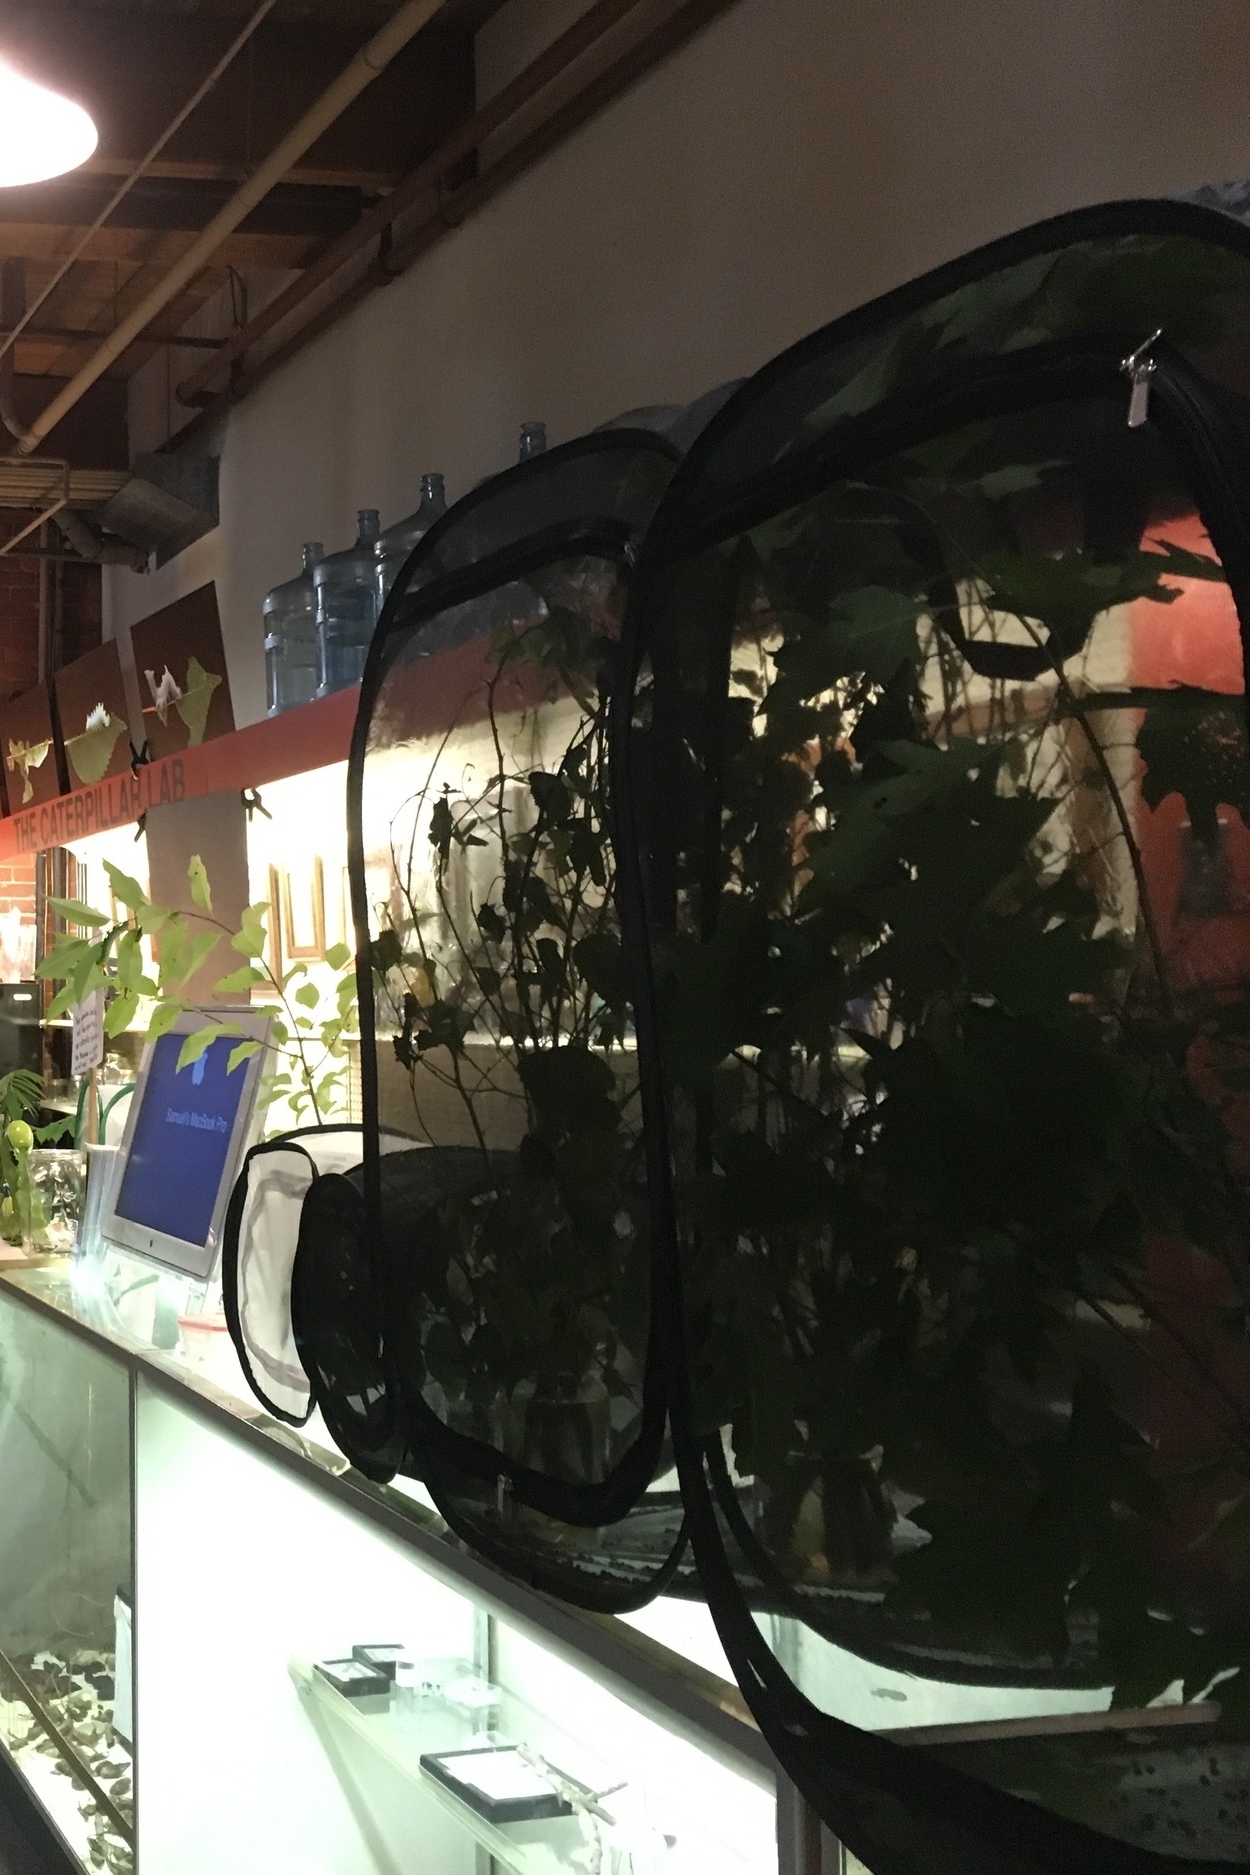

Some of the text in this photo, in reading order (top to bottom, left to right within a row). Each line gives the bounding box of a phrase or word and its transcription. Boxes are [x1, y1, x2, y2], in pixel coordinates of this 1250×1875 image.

[13, 757, 186, 853] THE CATERPILLAR LAB
